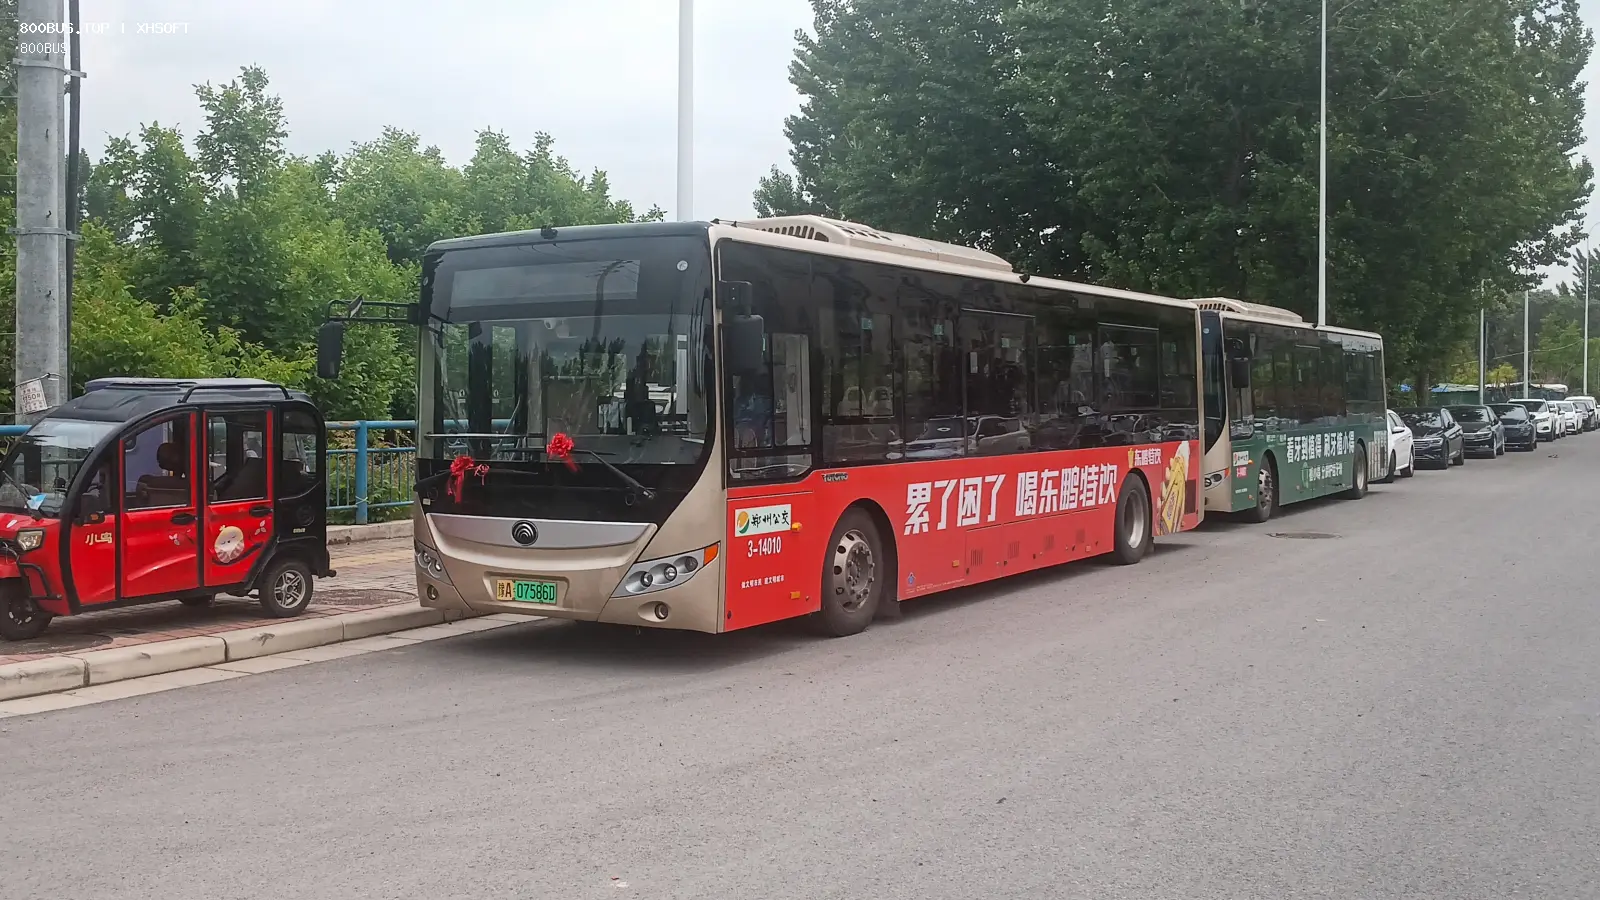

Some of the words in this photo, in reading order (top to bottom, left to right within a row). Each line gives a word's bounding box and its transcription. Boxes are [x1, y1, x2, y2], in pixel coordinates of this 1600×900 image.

[903, 473, 1006, 536] 累了困了
[1015, 462, 1118, 517] 喝东鹏特饮
[751, 510, 790, 528] 郑州公交
[747, 536, 782, 558] 3-14010
